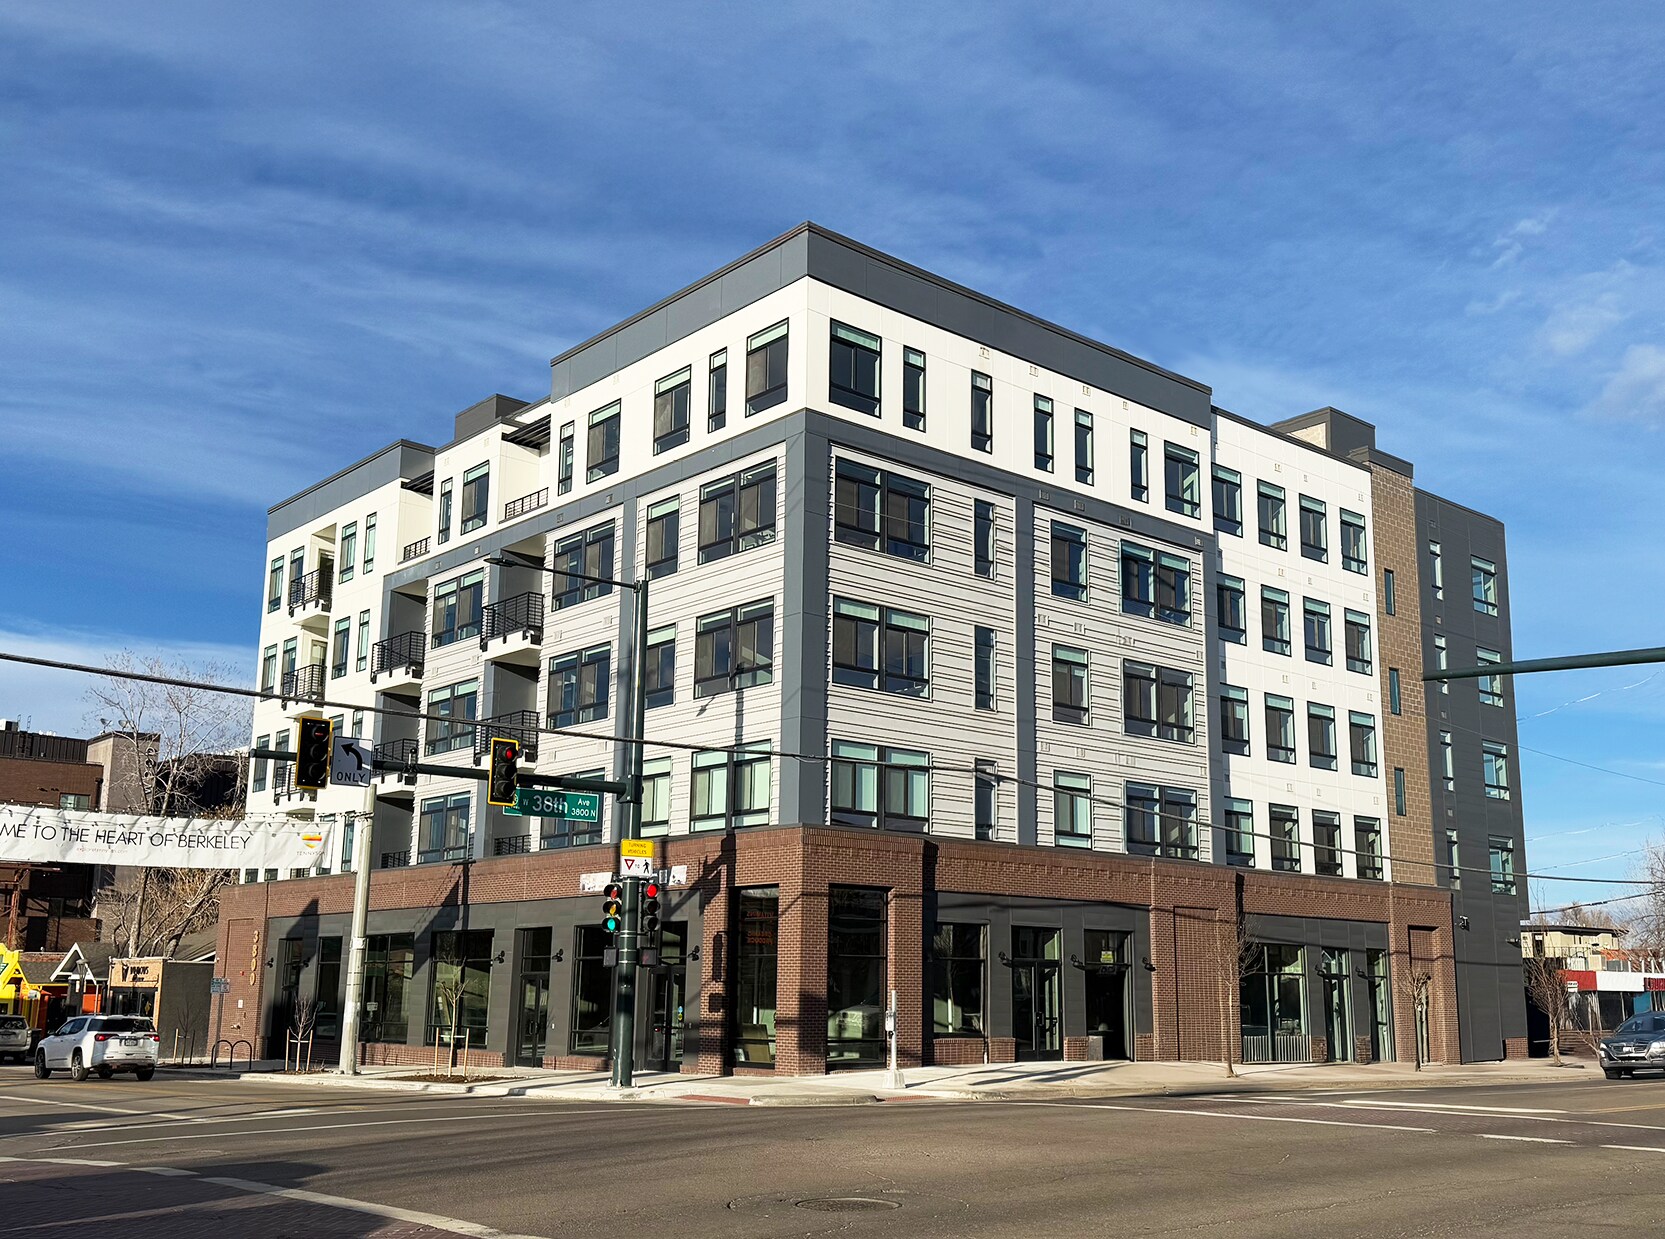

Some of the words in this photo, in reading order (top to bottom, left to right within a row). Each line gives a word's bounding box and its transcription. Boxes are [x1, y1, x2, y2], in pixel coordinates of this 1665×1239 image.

[336, 771, 366, 783] ONLY
[522, 798, 529, 806] W
[532, 795, 568, 813] 38th
[577, 798, 591, 807] Ave
[571, 808, 590, 817] 3800
[33, 825, 57, 840] TO
[61, 826, 90, 842] THE
[95, 830, 146, 846] HEART
[150, 833, 174, 847] OF
[177, 835, 251, 849] BERKELEY
[250, 930, 260, 986] 3800
